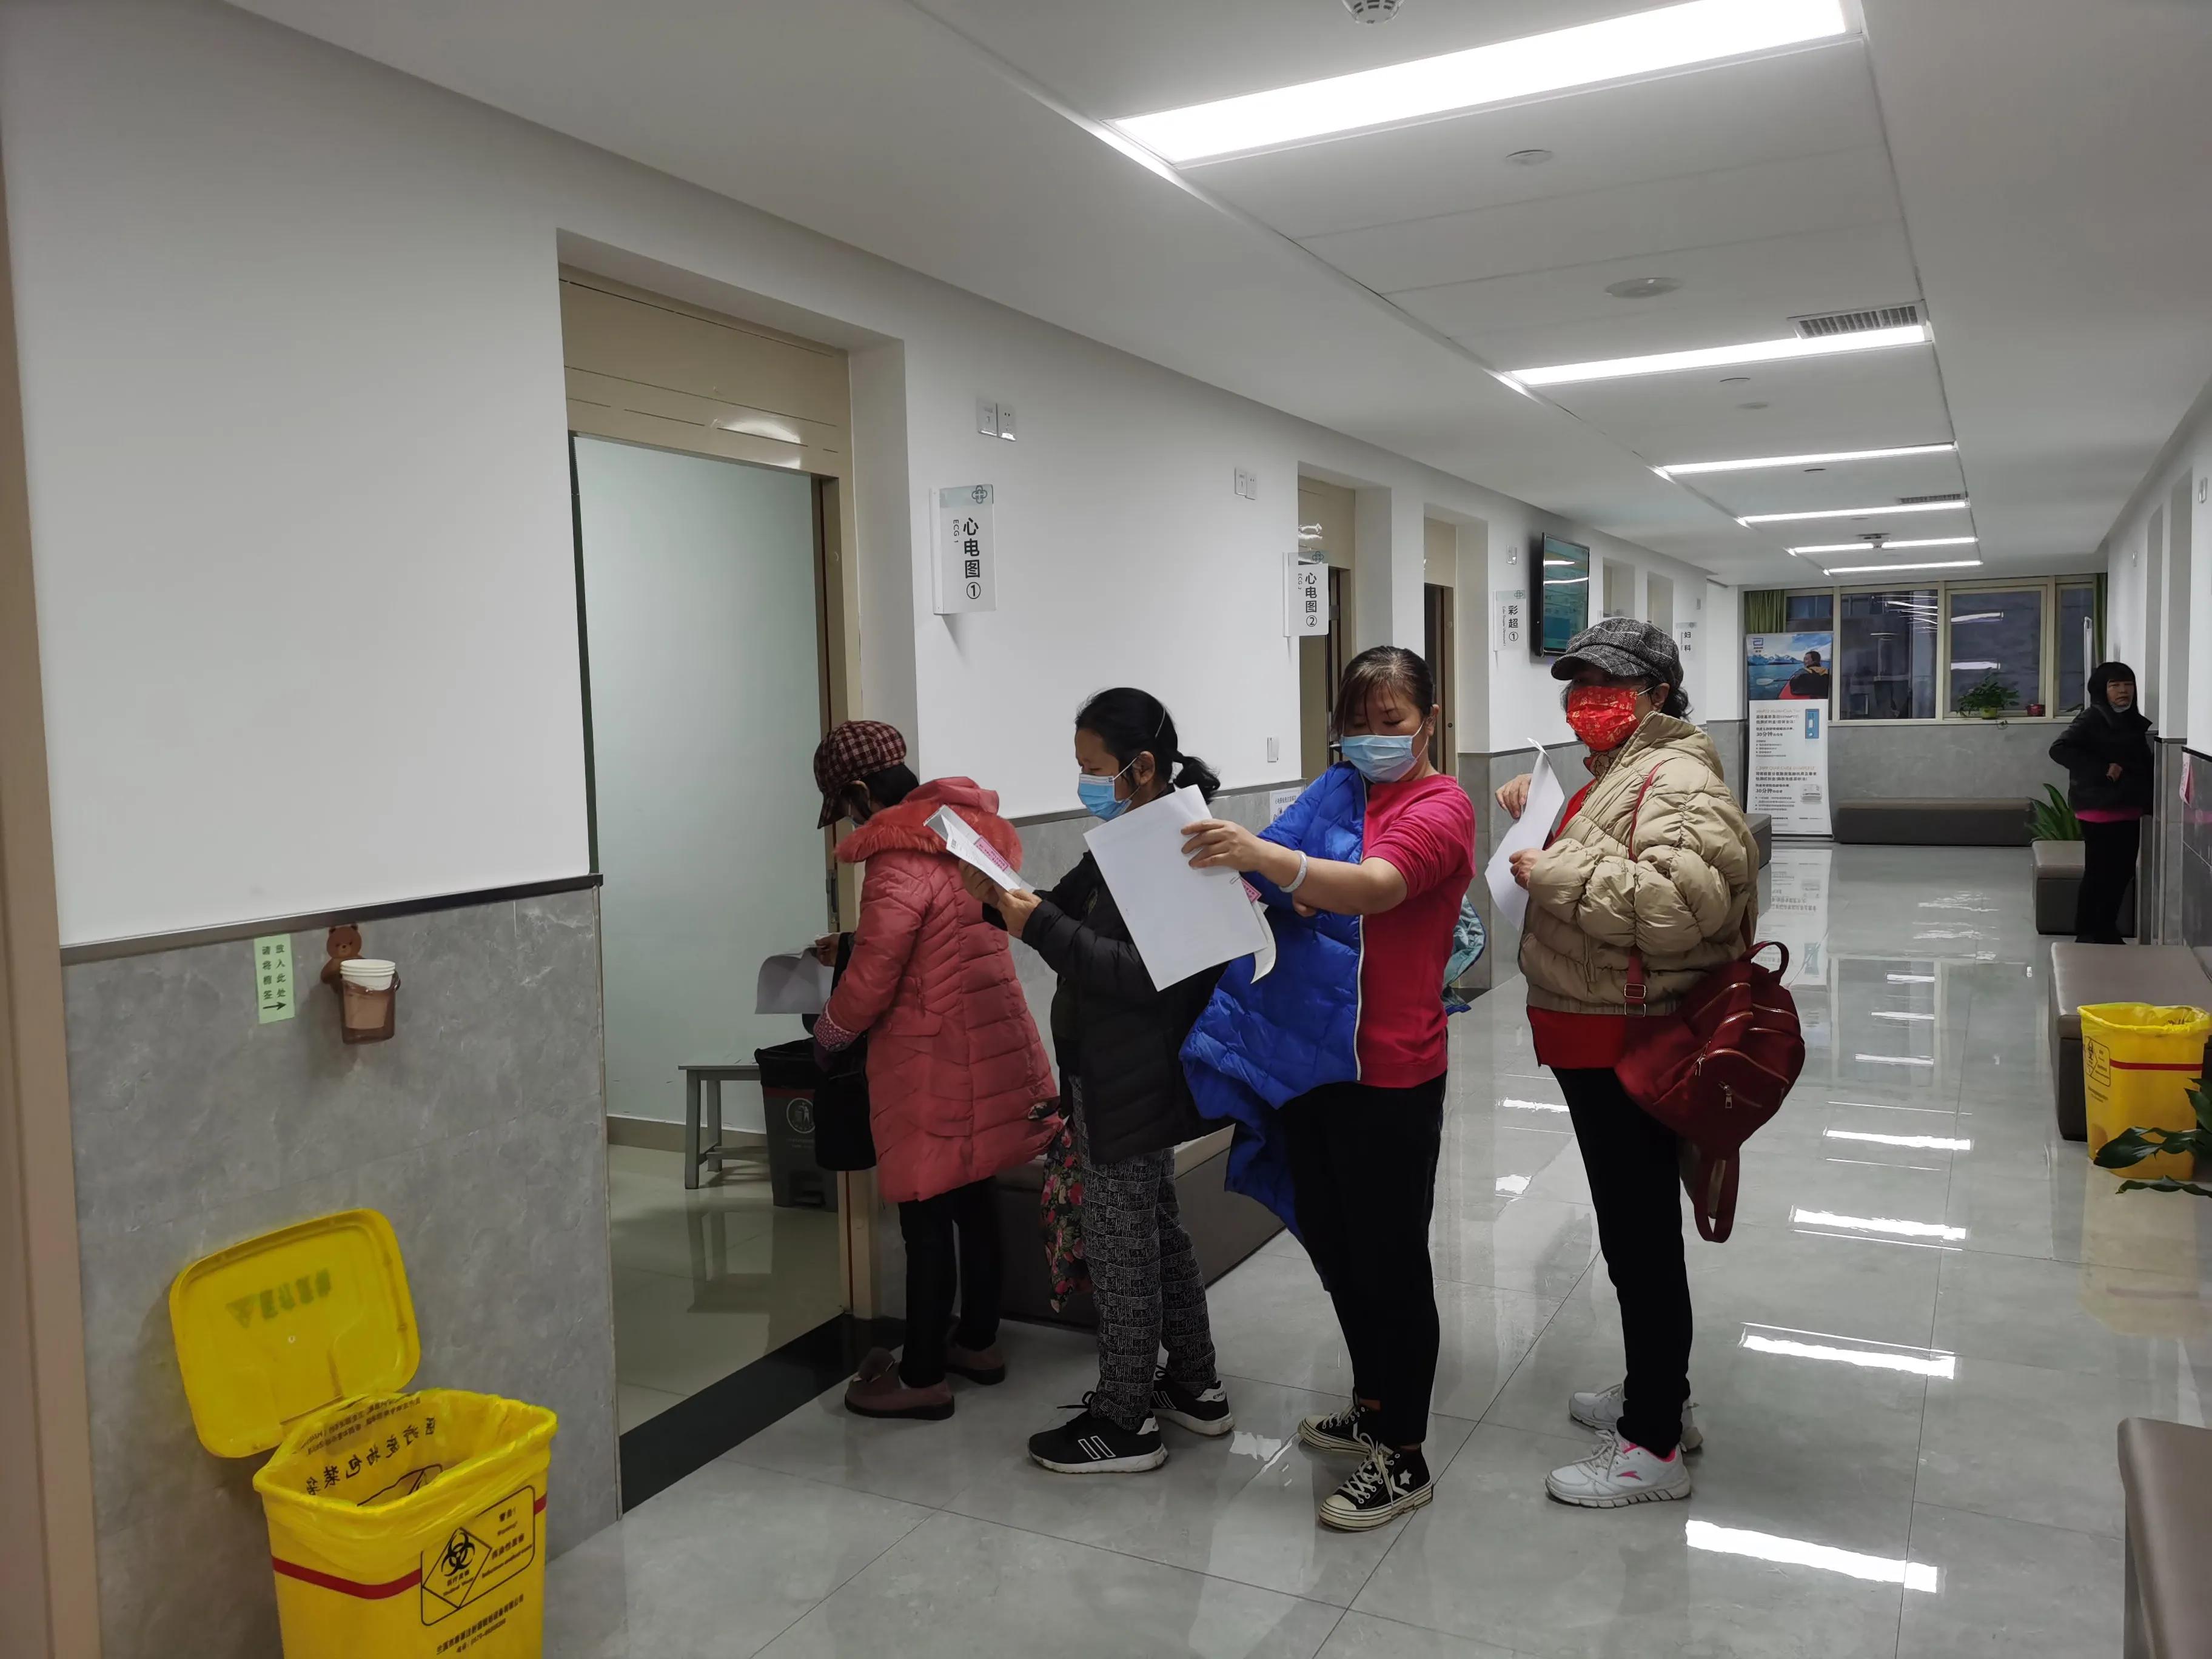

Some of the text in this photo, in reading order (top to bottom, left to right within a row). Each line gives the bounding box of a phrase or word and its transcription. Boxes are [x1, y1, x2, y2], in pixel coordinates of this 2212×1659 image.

[963, 517, 981, 600] 心电图①
[1305, 572, 1317, 628] 心电图②
[1508, 605, 1519, 642] 彩超①
